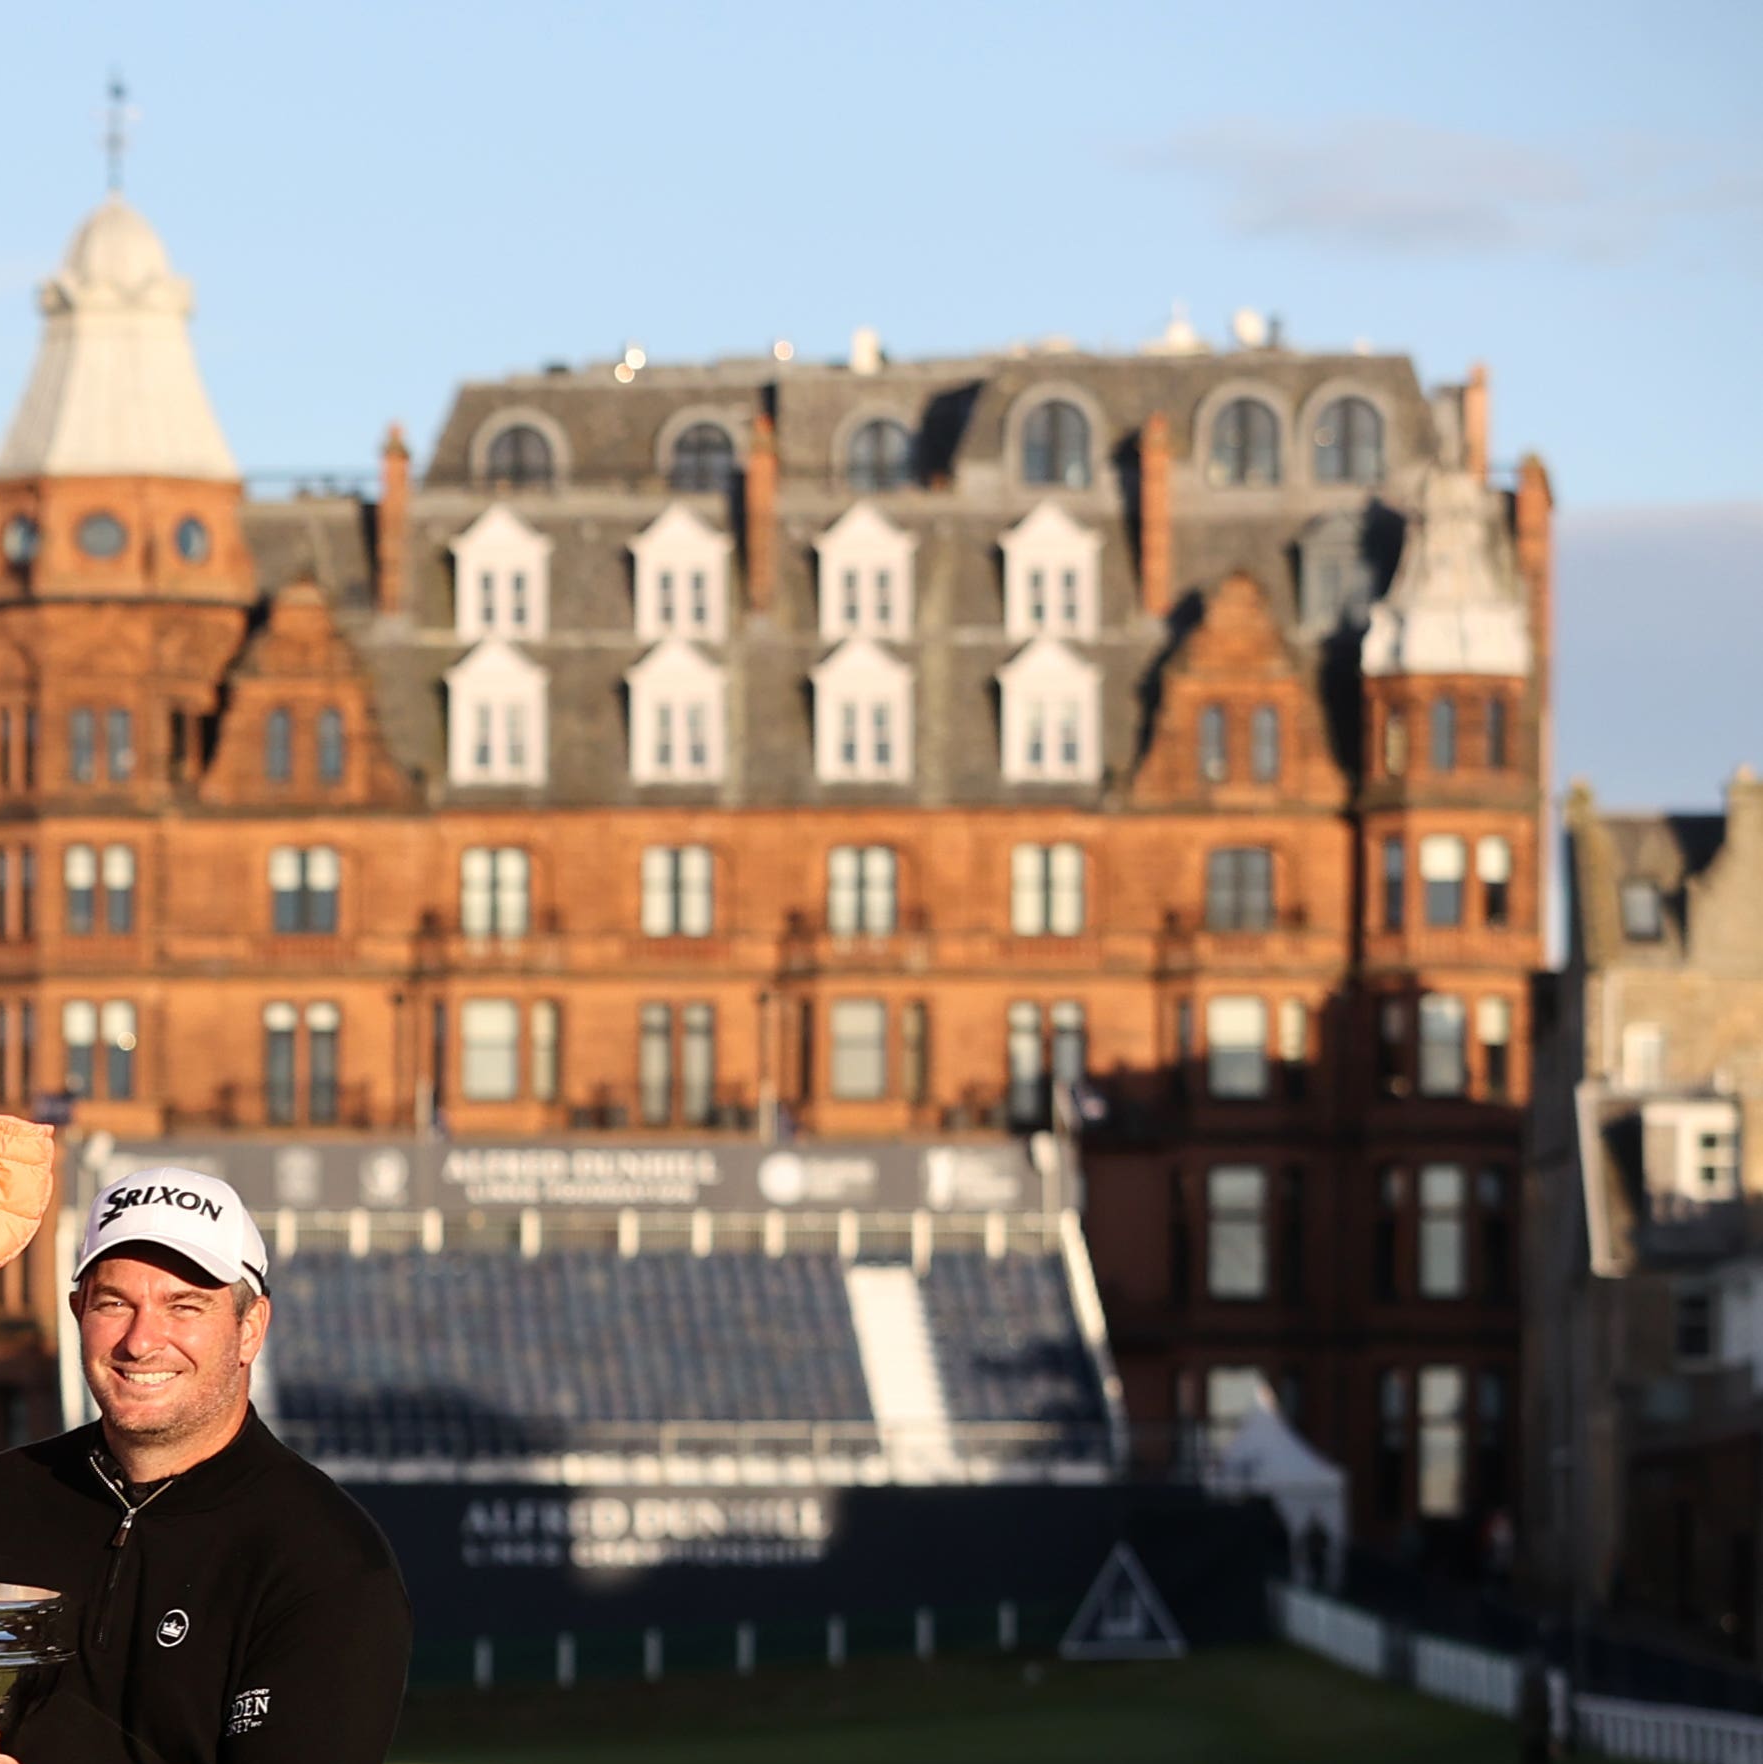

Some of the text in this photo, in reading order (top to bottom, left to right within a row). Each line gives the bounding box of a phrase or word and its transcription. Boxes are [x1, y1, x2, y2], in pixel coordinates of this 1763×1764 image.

[98, 1186, 224, 1232] SRIXON
[461, 1499, 832, 1540] ALFRED DUNHILL
